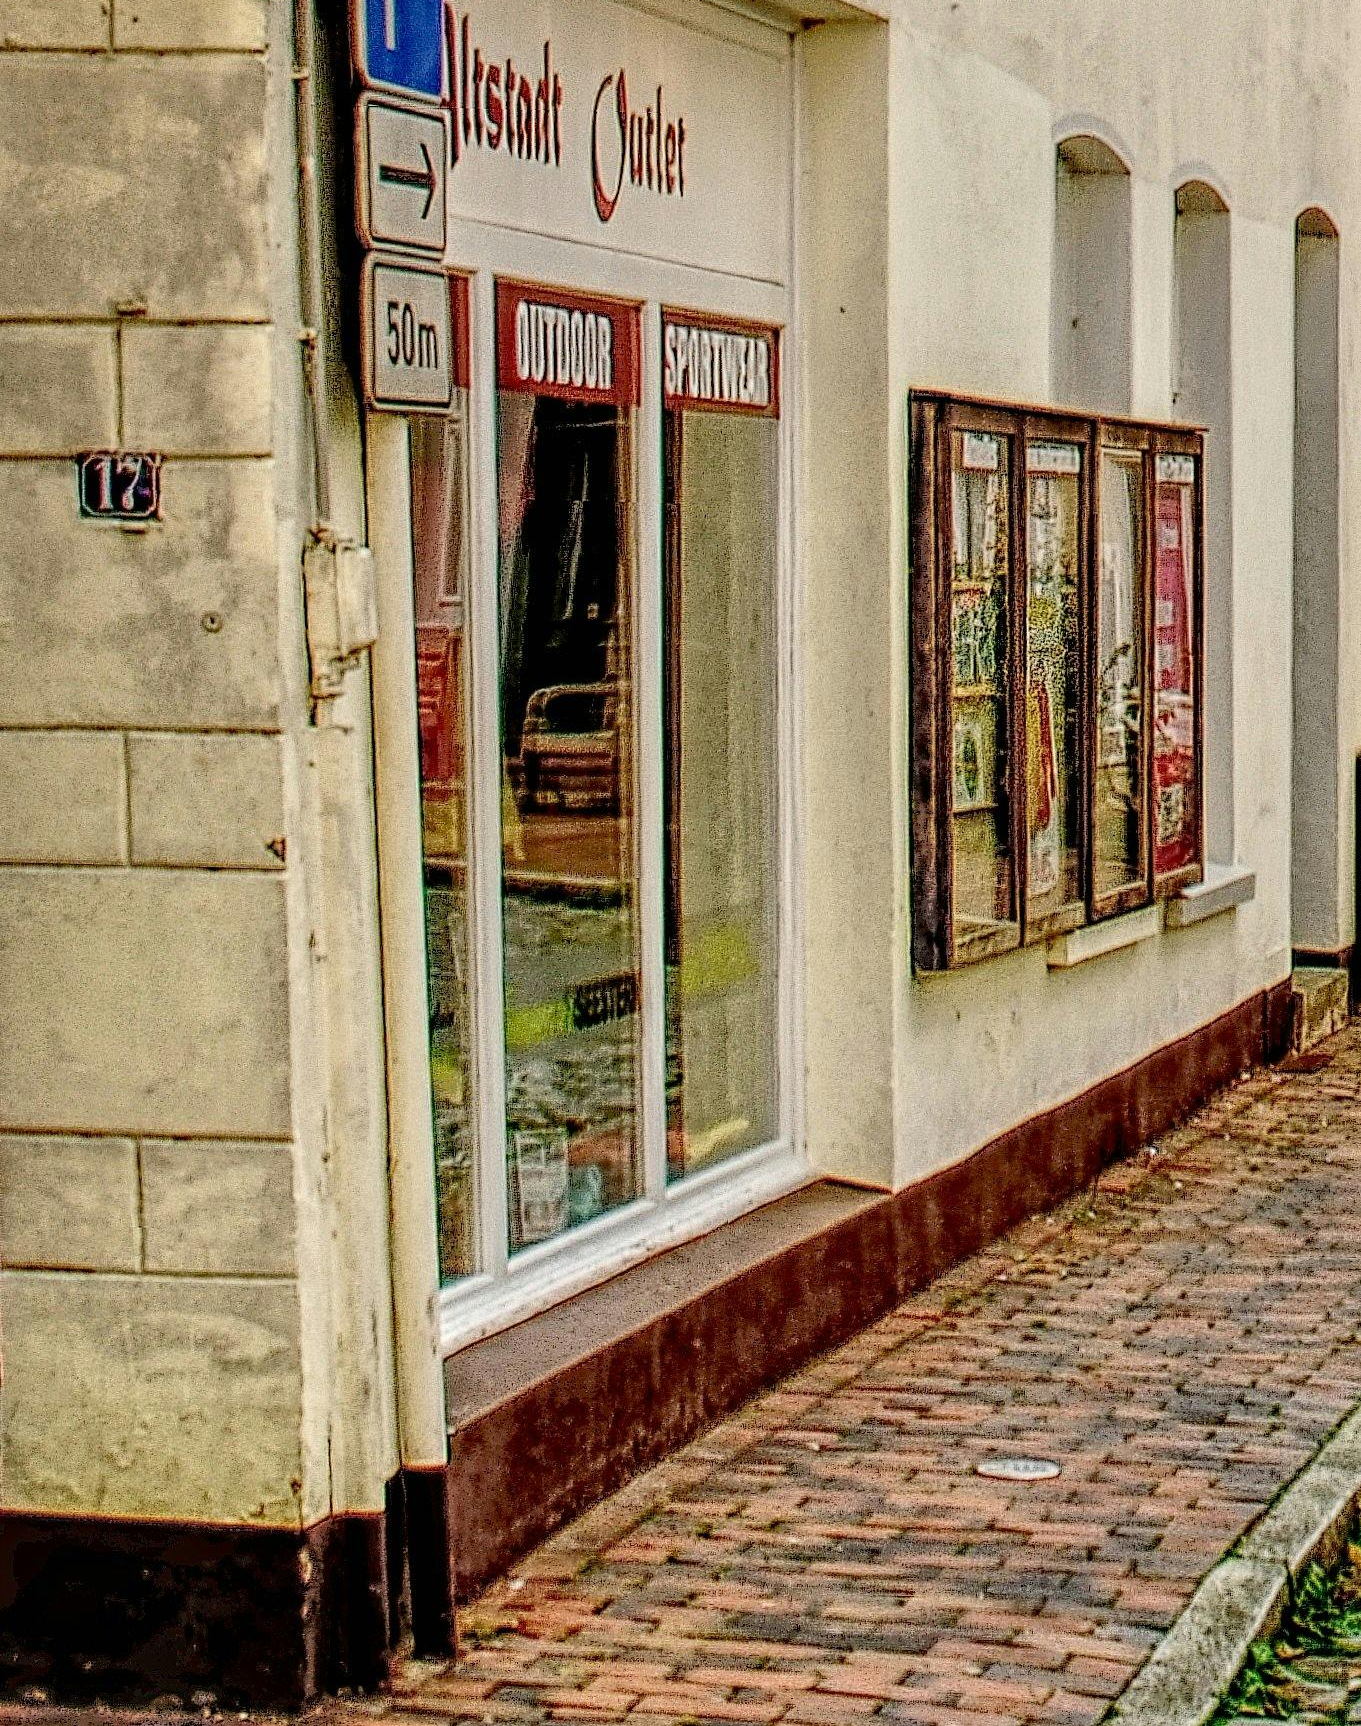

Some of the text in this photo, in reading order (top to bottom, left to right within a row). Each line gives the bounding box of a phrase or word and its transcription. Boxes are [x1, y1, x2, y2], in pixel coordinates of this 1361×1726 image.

[591, 67, 685, 223] Outlet
[516, 300, 612, 389] OUTDOOR
[664, 324, 769, 406] SPORTWEAR
[94, 456, 143, 509] 17
